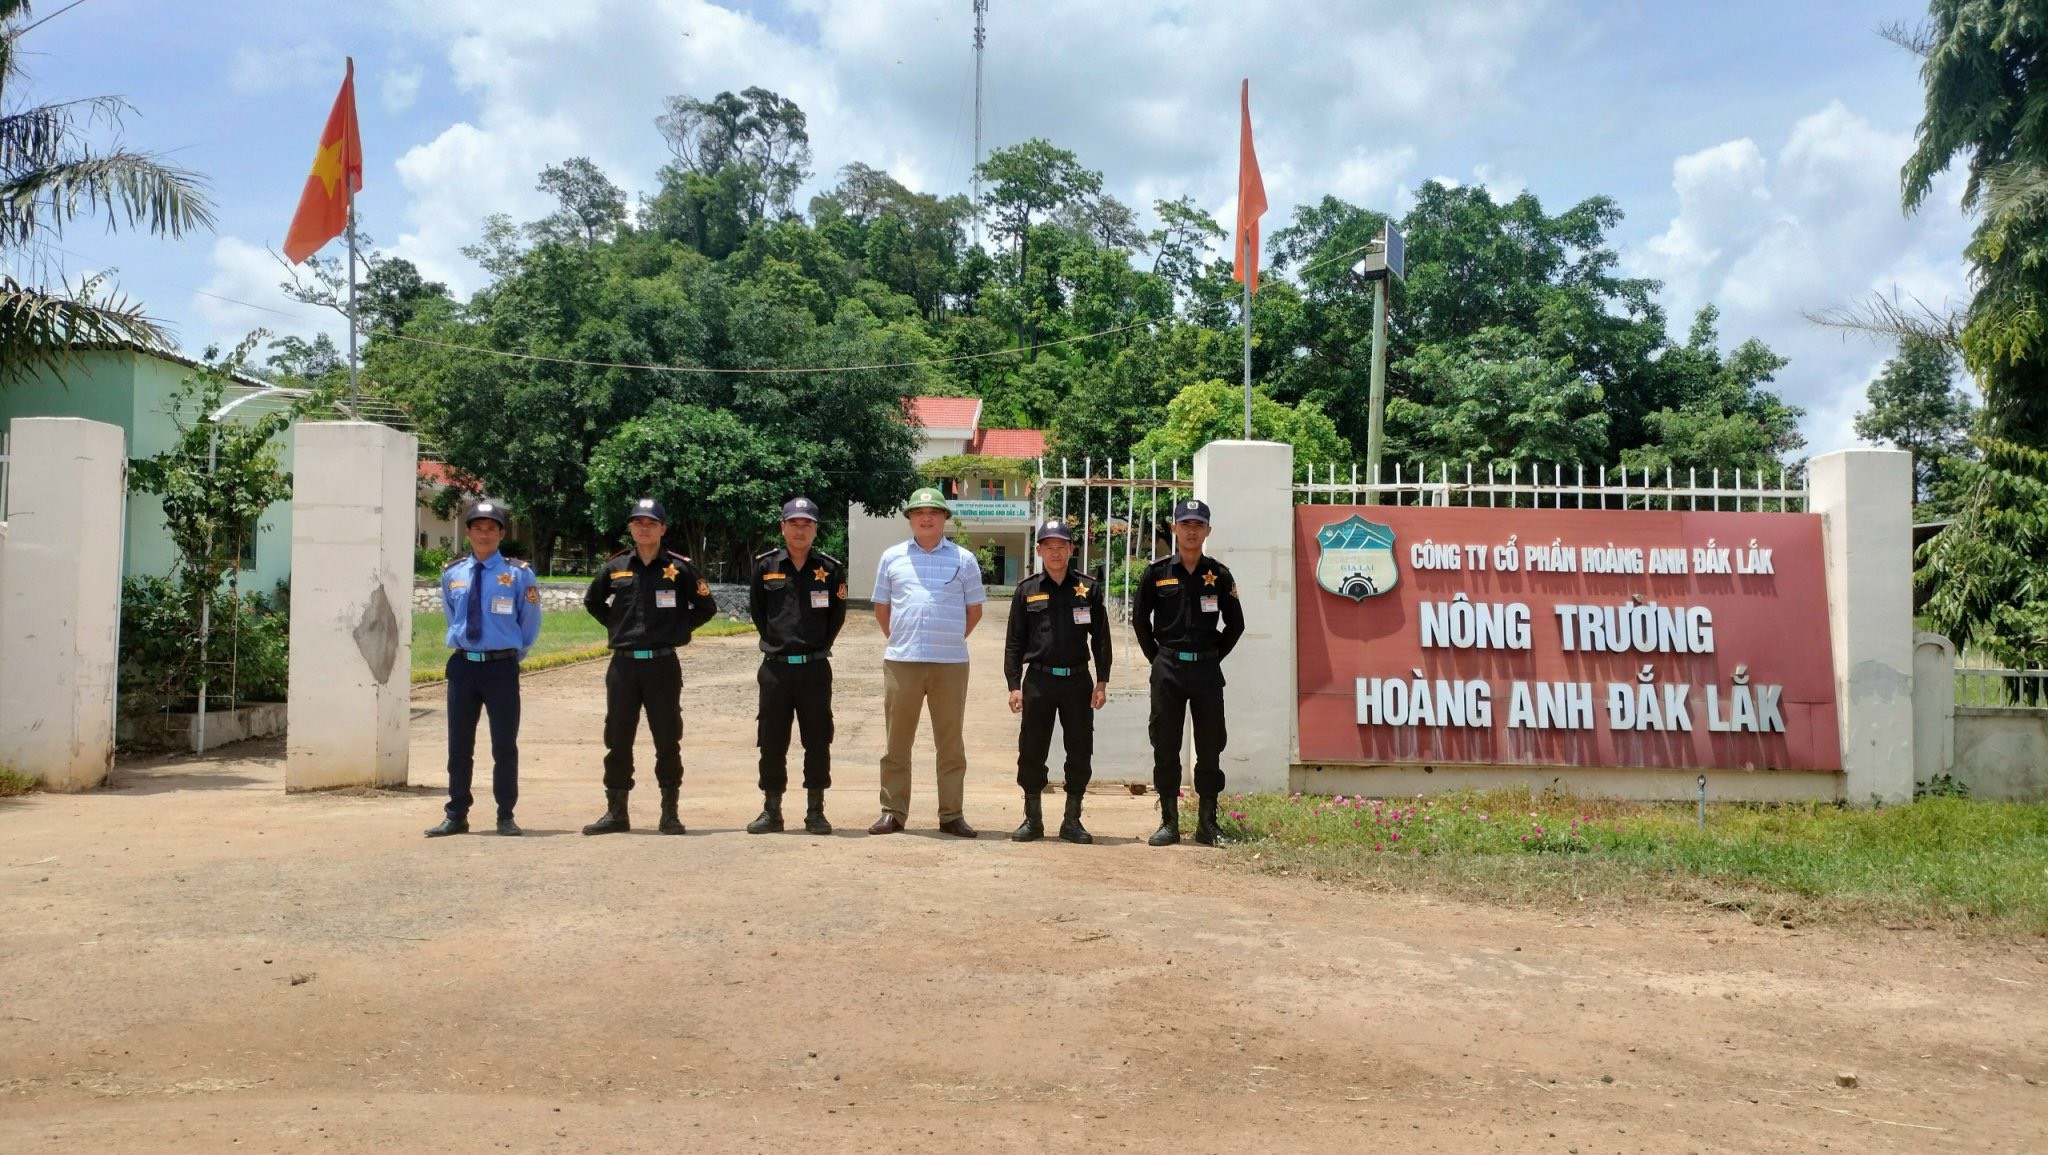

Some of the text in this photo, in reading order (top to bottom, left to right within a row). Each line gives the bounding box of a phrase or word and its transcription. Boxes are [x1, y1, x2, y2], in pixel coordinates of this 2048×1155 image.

[1410, 534, 1775, 575] CÔNG TY CỔ PHẦN HOÀNG ANH ĐẮK LẮK
[1420, 592, 1715, 653] NÔNG TRƯỜNG
[1355, 664, 1786, 732] HOÀNG ANH ĐẮK LẮK
